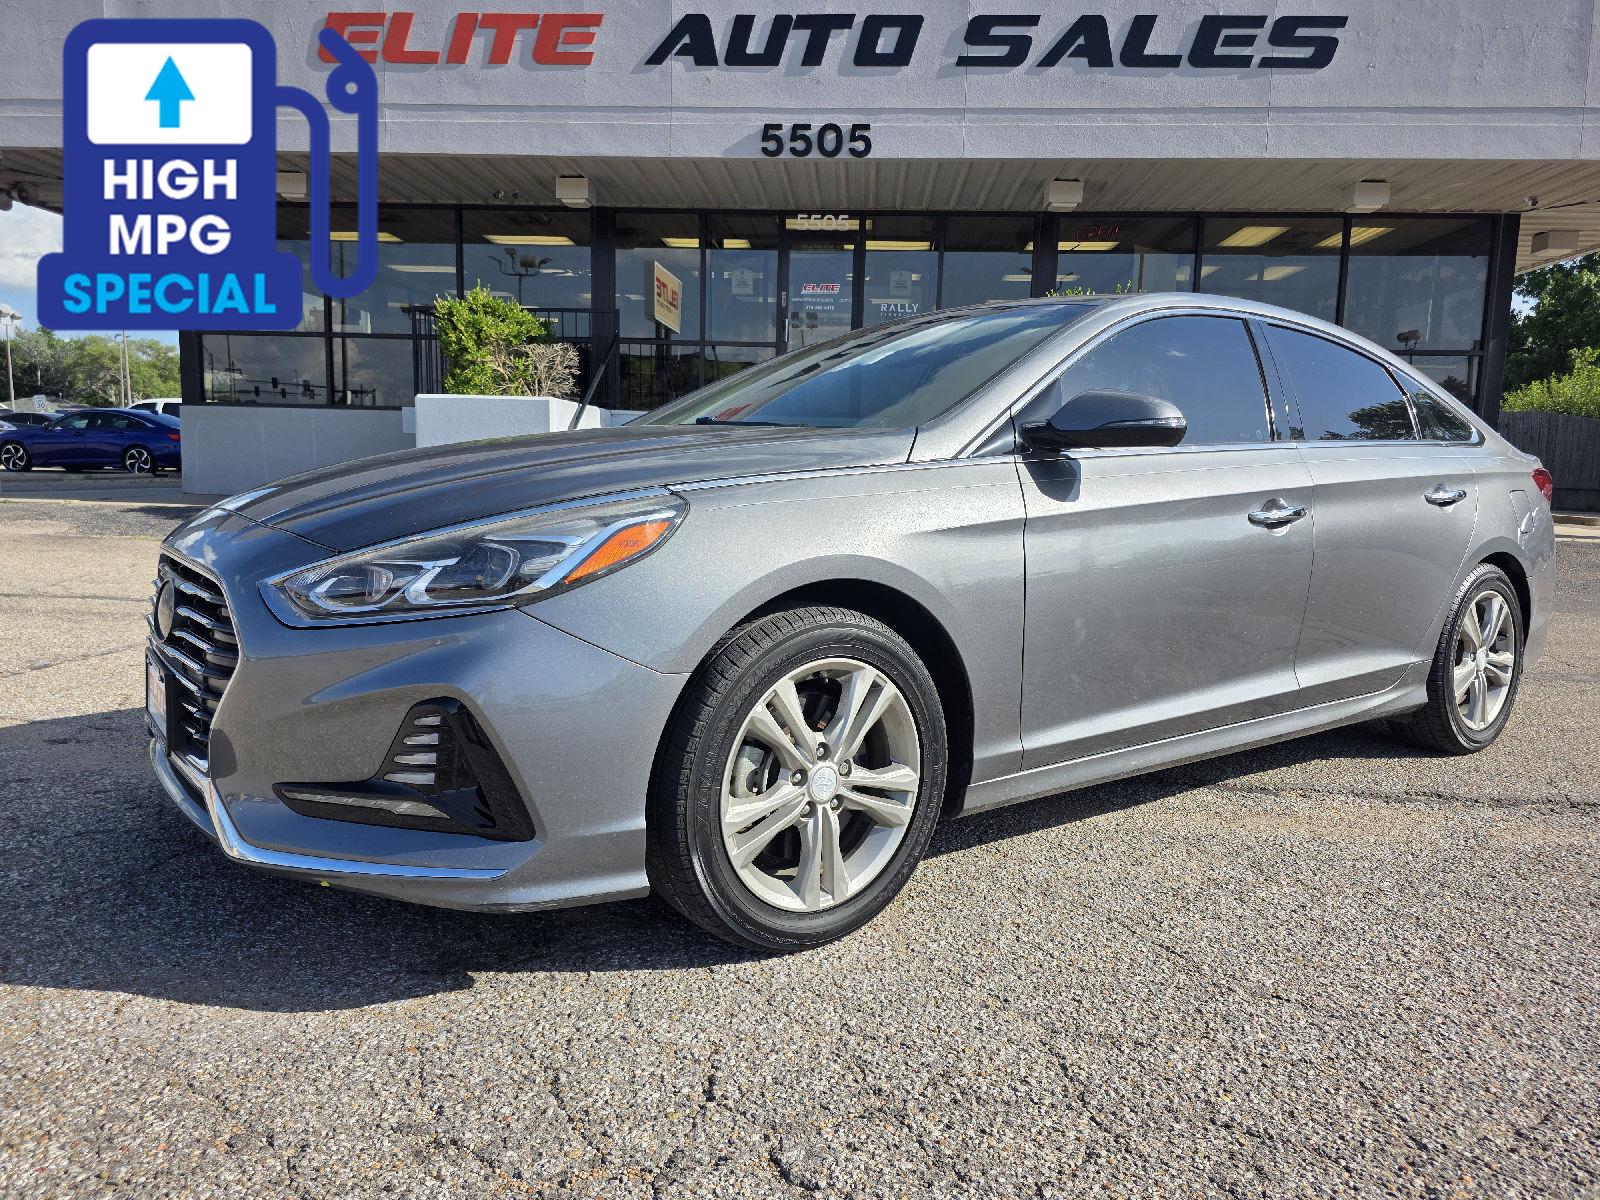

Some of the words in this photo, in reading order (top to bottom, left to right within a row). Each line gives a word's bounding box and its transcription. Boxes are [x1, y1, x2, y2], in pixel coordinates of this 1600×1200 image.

[317, 12, 604, 65] ELITE
[645, 14, 925, 67] AUTO
[956, 14, 1349, 69] SALES
[761, 123, 872, 157] 5505
[880, 303, 919, 312] RALLY
